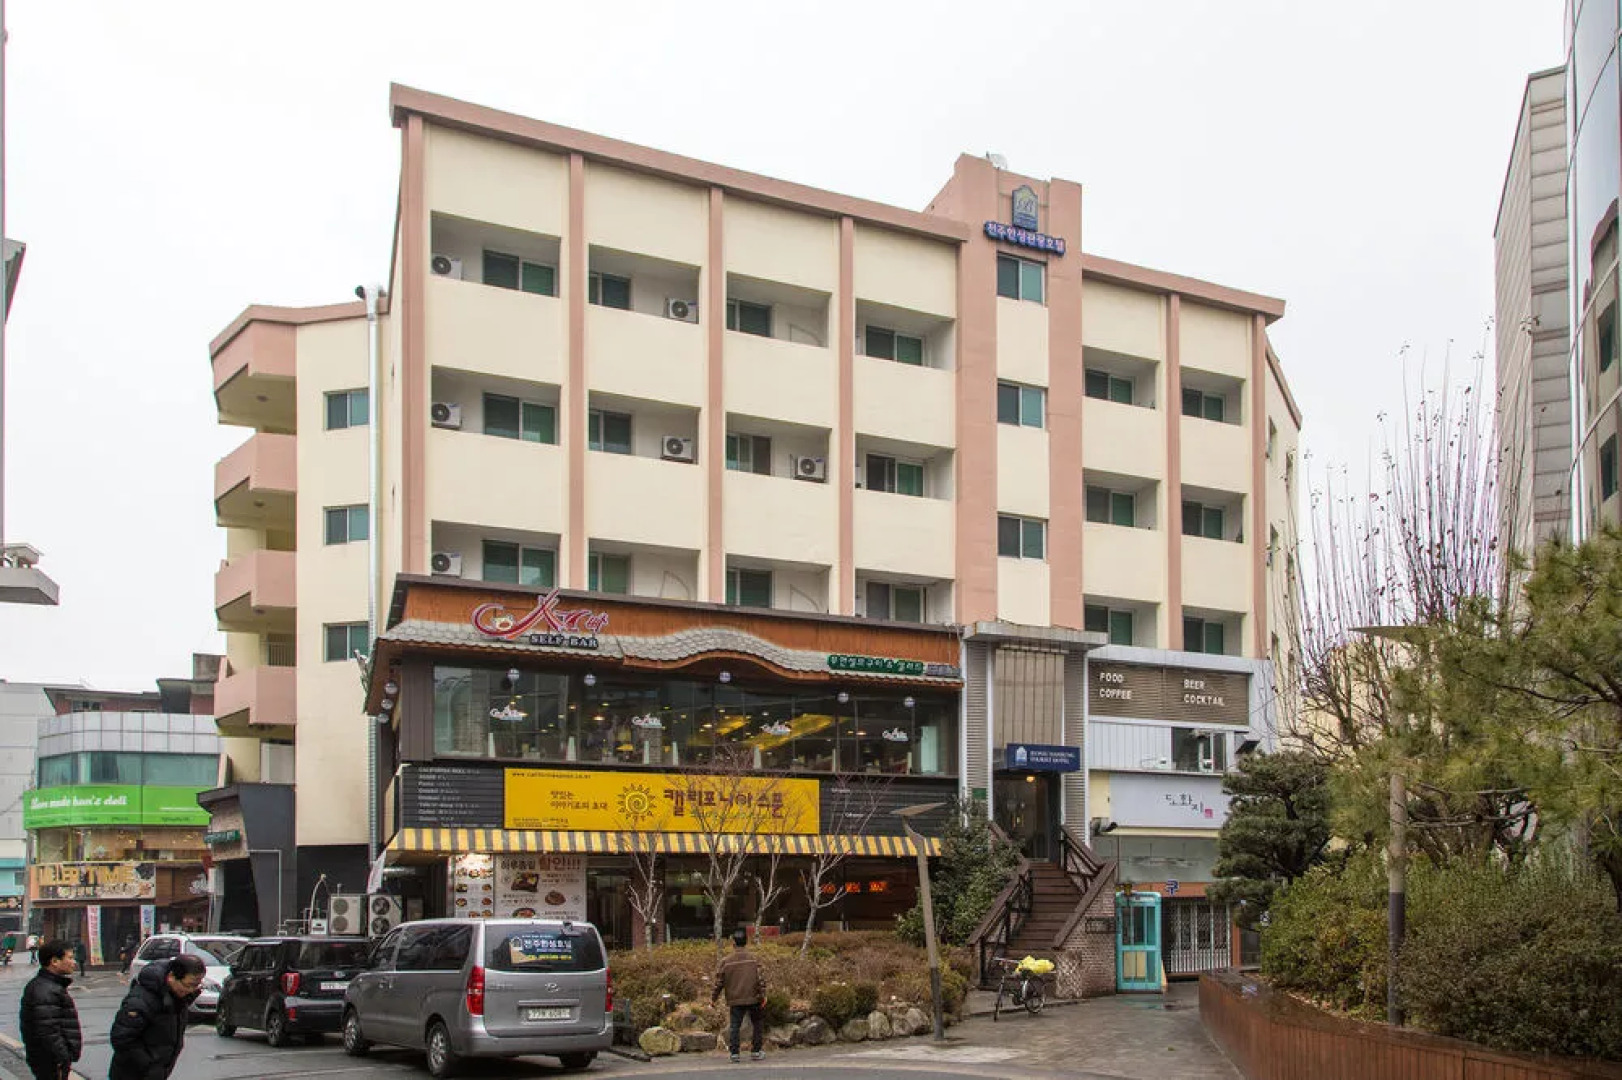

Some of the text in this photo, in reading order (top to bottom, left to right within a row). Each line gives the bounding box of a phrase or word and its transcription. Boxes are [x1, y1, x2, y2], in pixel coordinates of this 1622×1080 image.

[987, 223, 1065, 254] 전주한성관광호텔
[530, 633, 598, 649] SELF BAR
[1100, 672, 1124, 684] FOOD
[1183, 678, 1205, 690] BEER
[1099, 688, 1133, 700] COFFEE
[1183, 693, 1226, 707] COCKTAIL
[1165, 793, 1204, 813] 도화지
